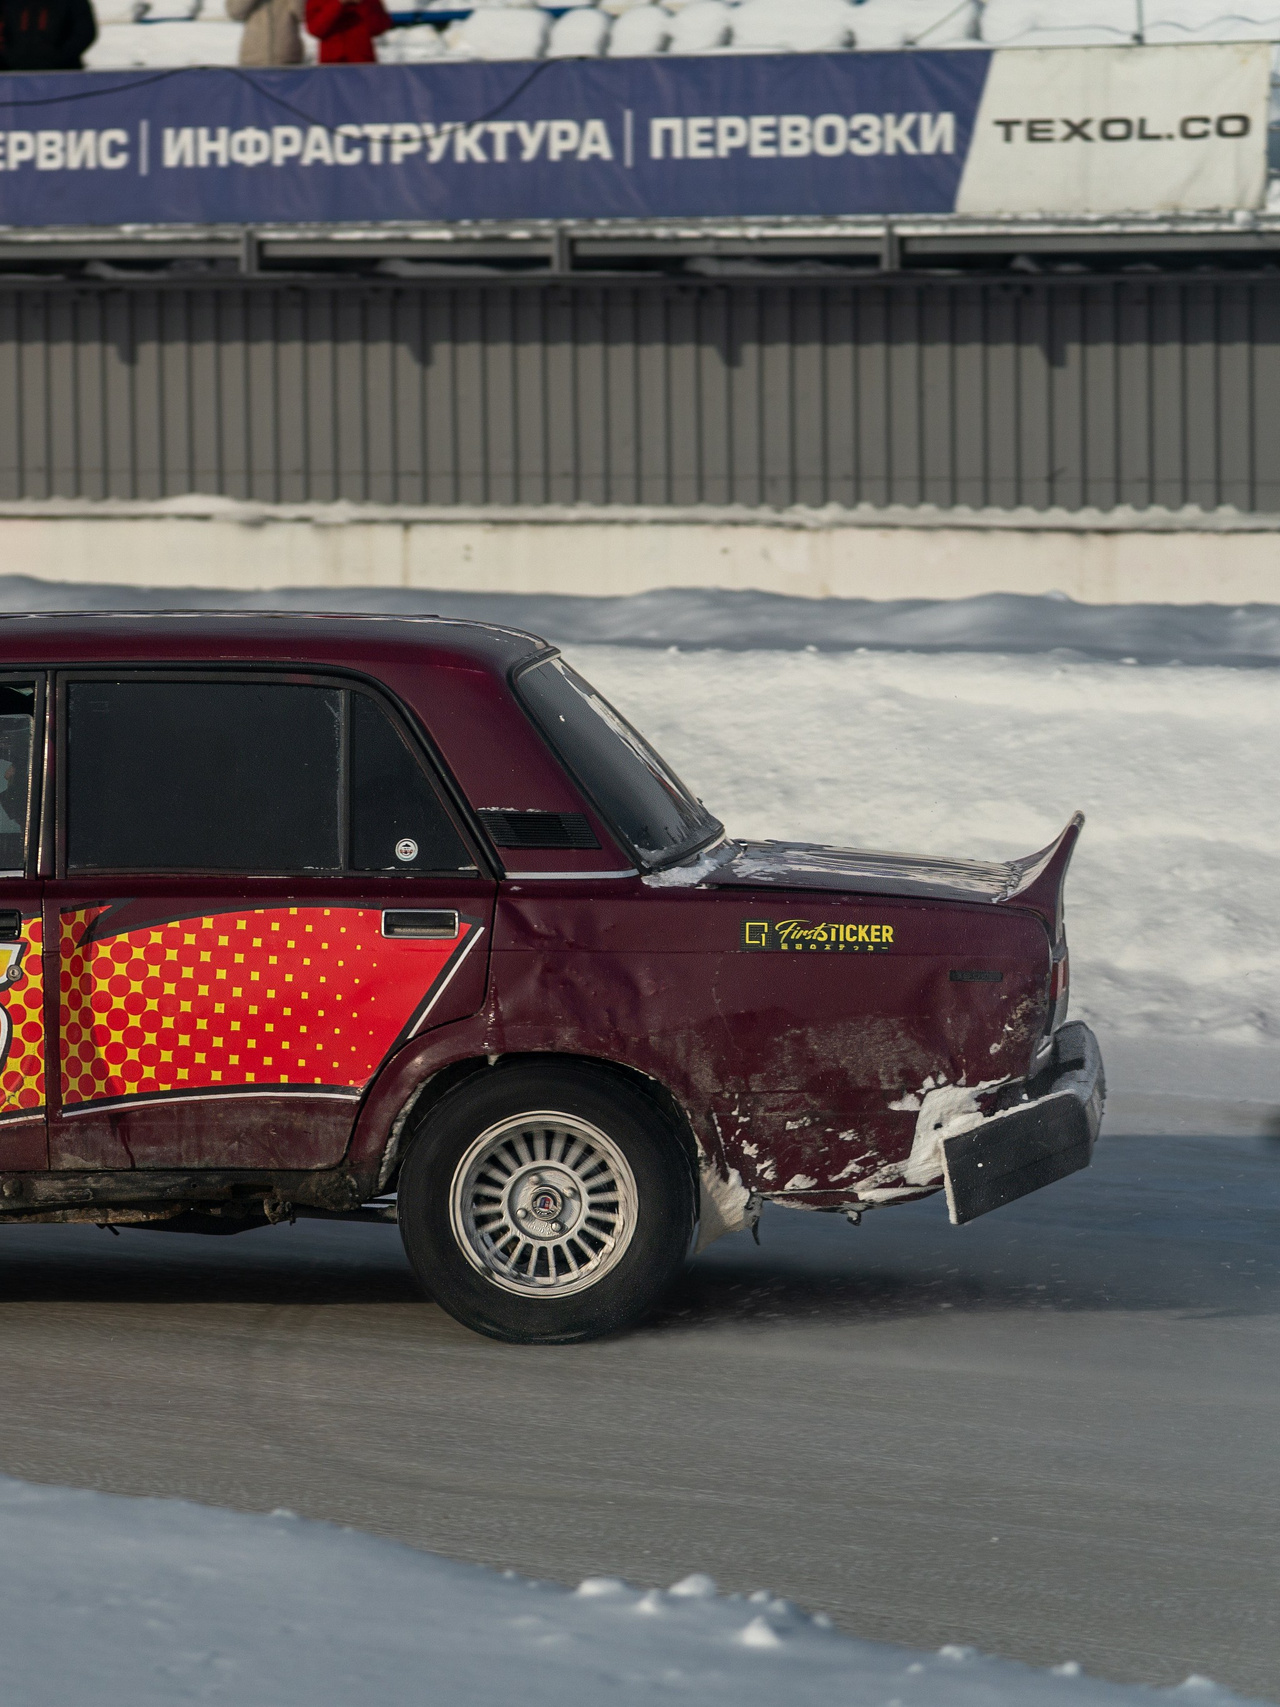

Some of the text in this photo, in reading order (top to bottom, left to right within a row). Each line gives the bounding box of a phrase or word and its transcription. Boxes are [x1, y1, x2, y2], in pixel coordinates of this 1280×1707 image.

[162, 119, 612, 168] ИНФРАСТРУКТУРА
[649, 111, 956, 161] ПЕРЕВОЗКИ
[993, 114, 1251, 143] TEXOL.CO
